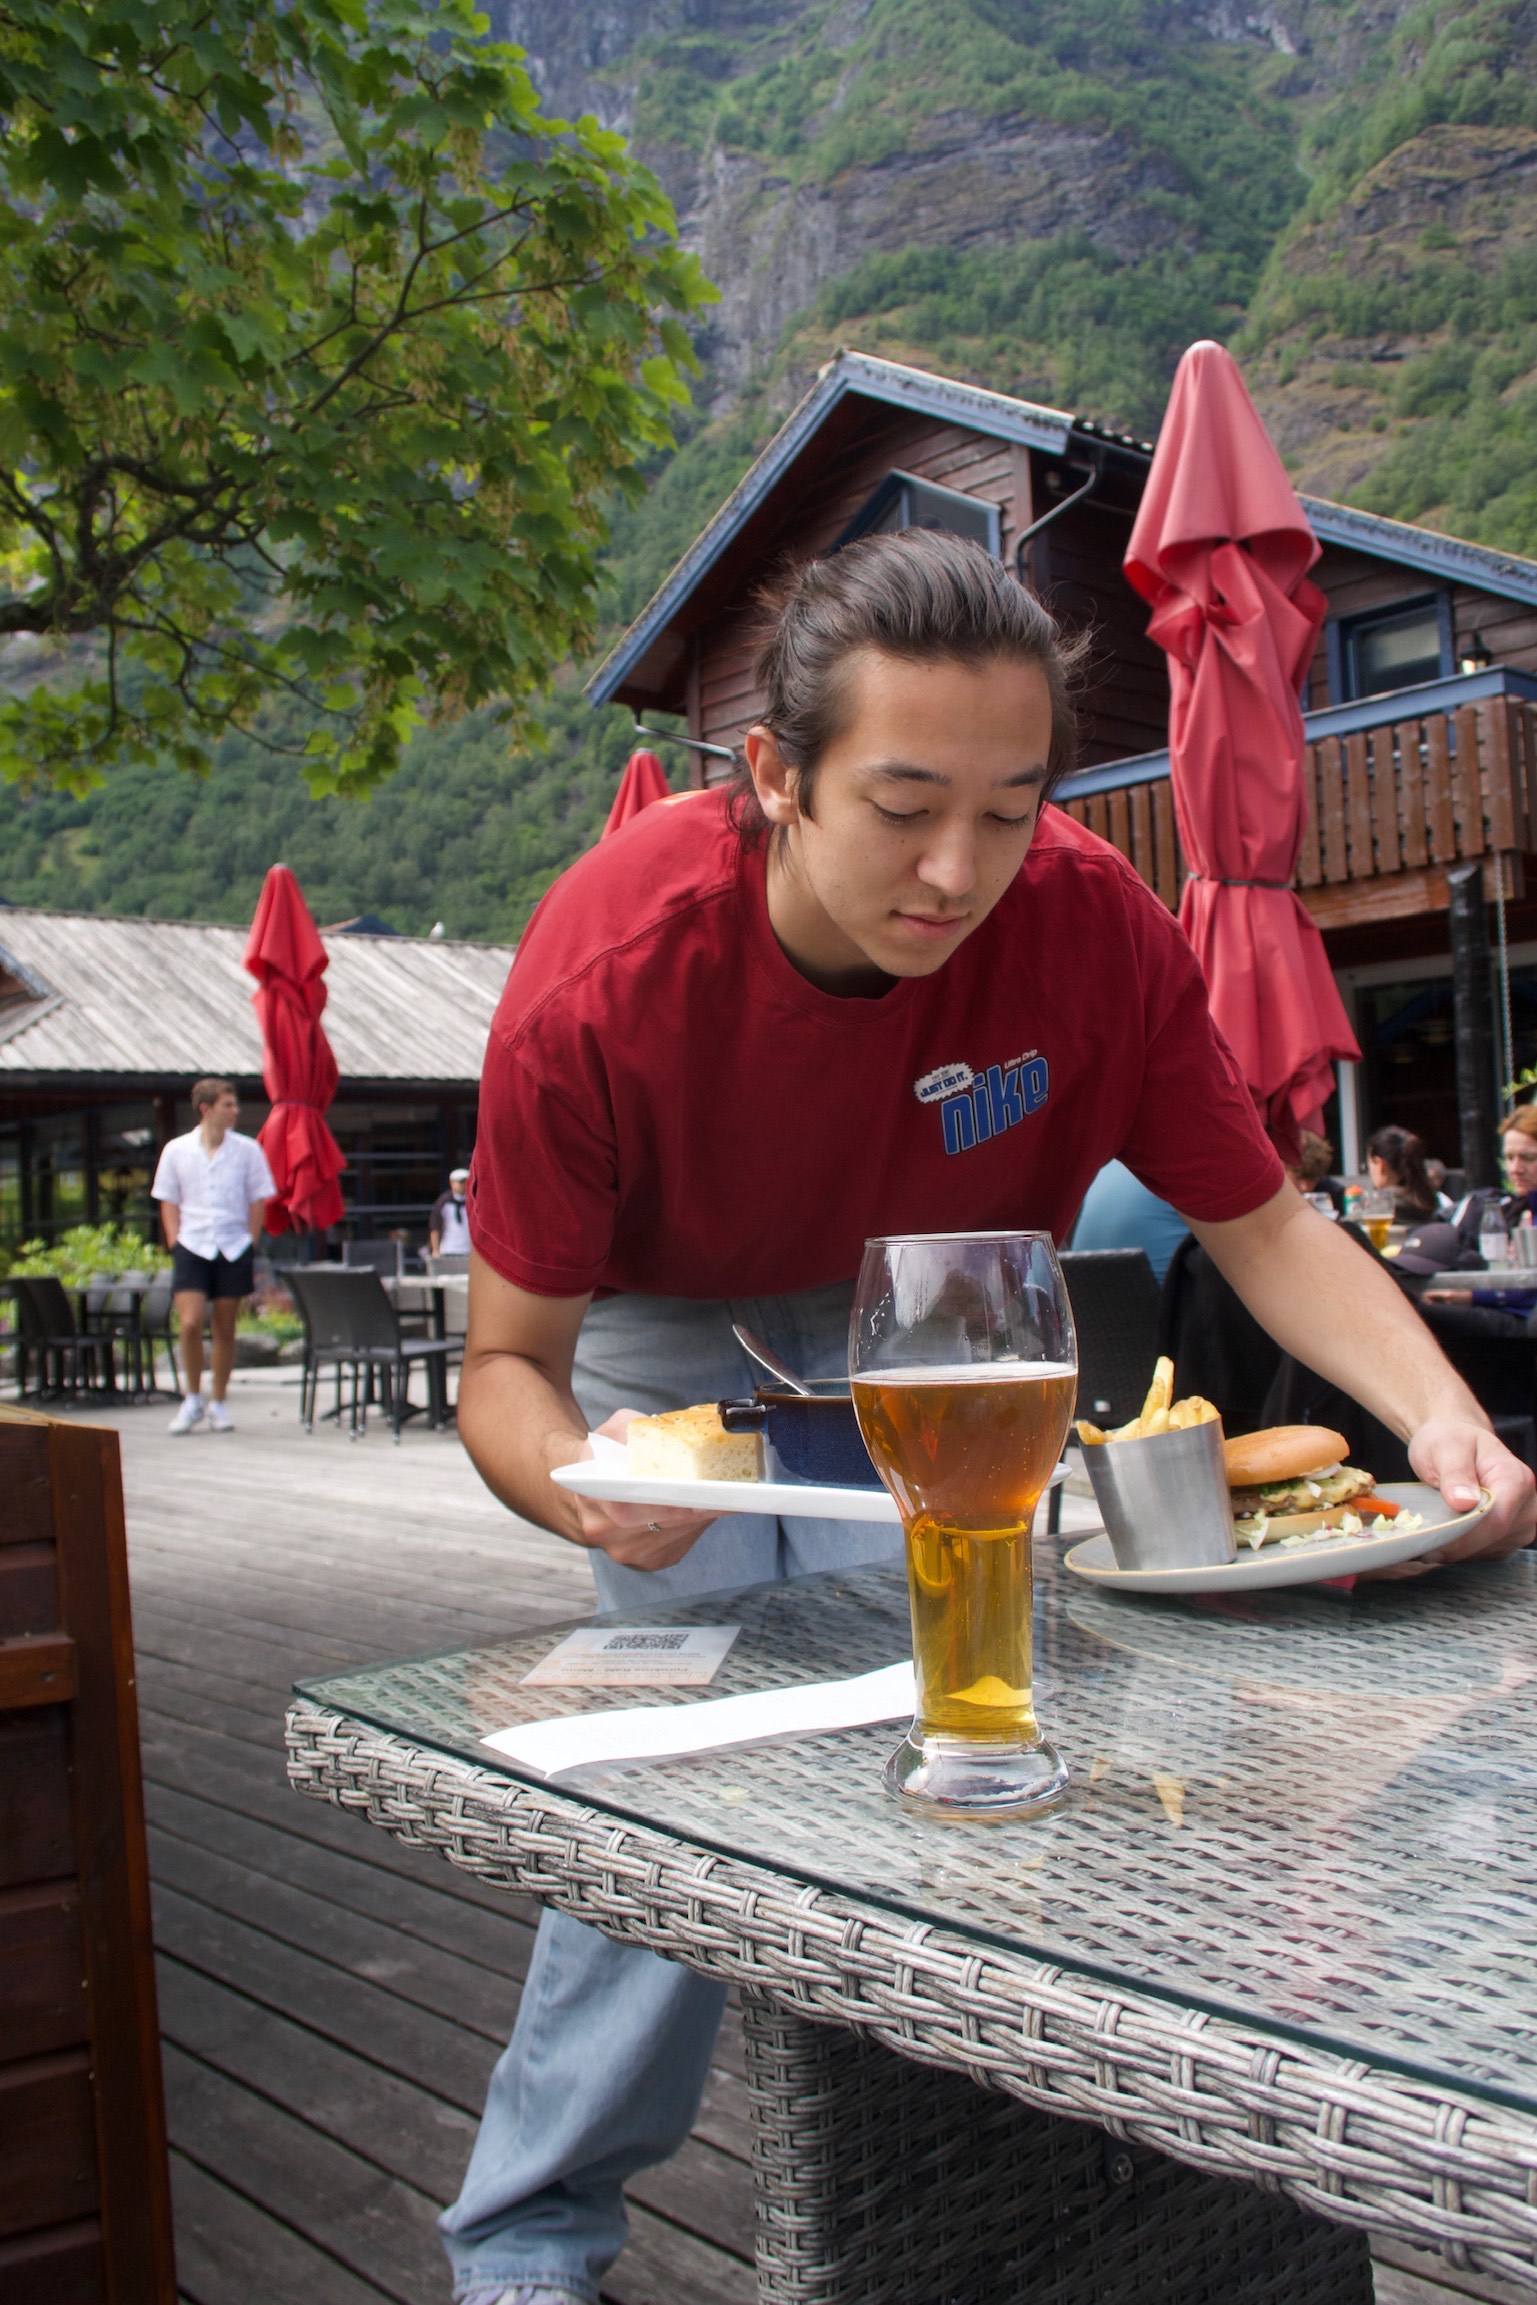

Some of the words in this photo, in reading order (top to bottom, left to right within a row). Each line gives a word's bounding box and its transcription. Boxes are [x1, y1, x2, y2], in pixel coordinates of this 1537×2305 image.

[921, 1081, 943, 1098] JUST
[944, 1076, 957, 1088] DO
[956, 1070, 968, 1083] IT.
[941, 1056, 1049, 1155] nike
